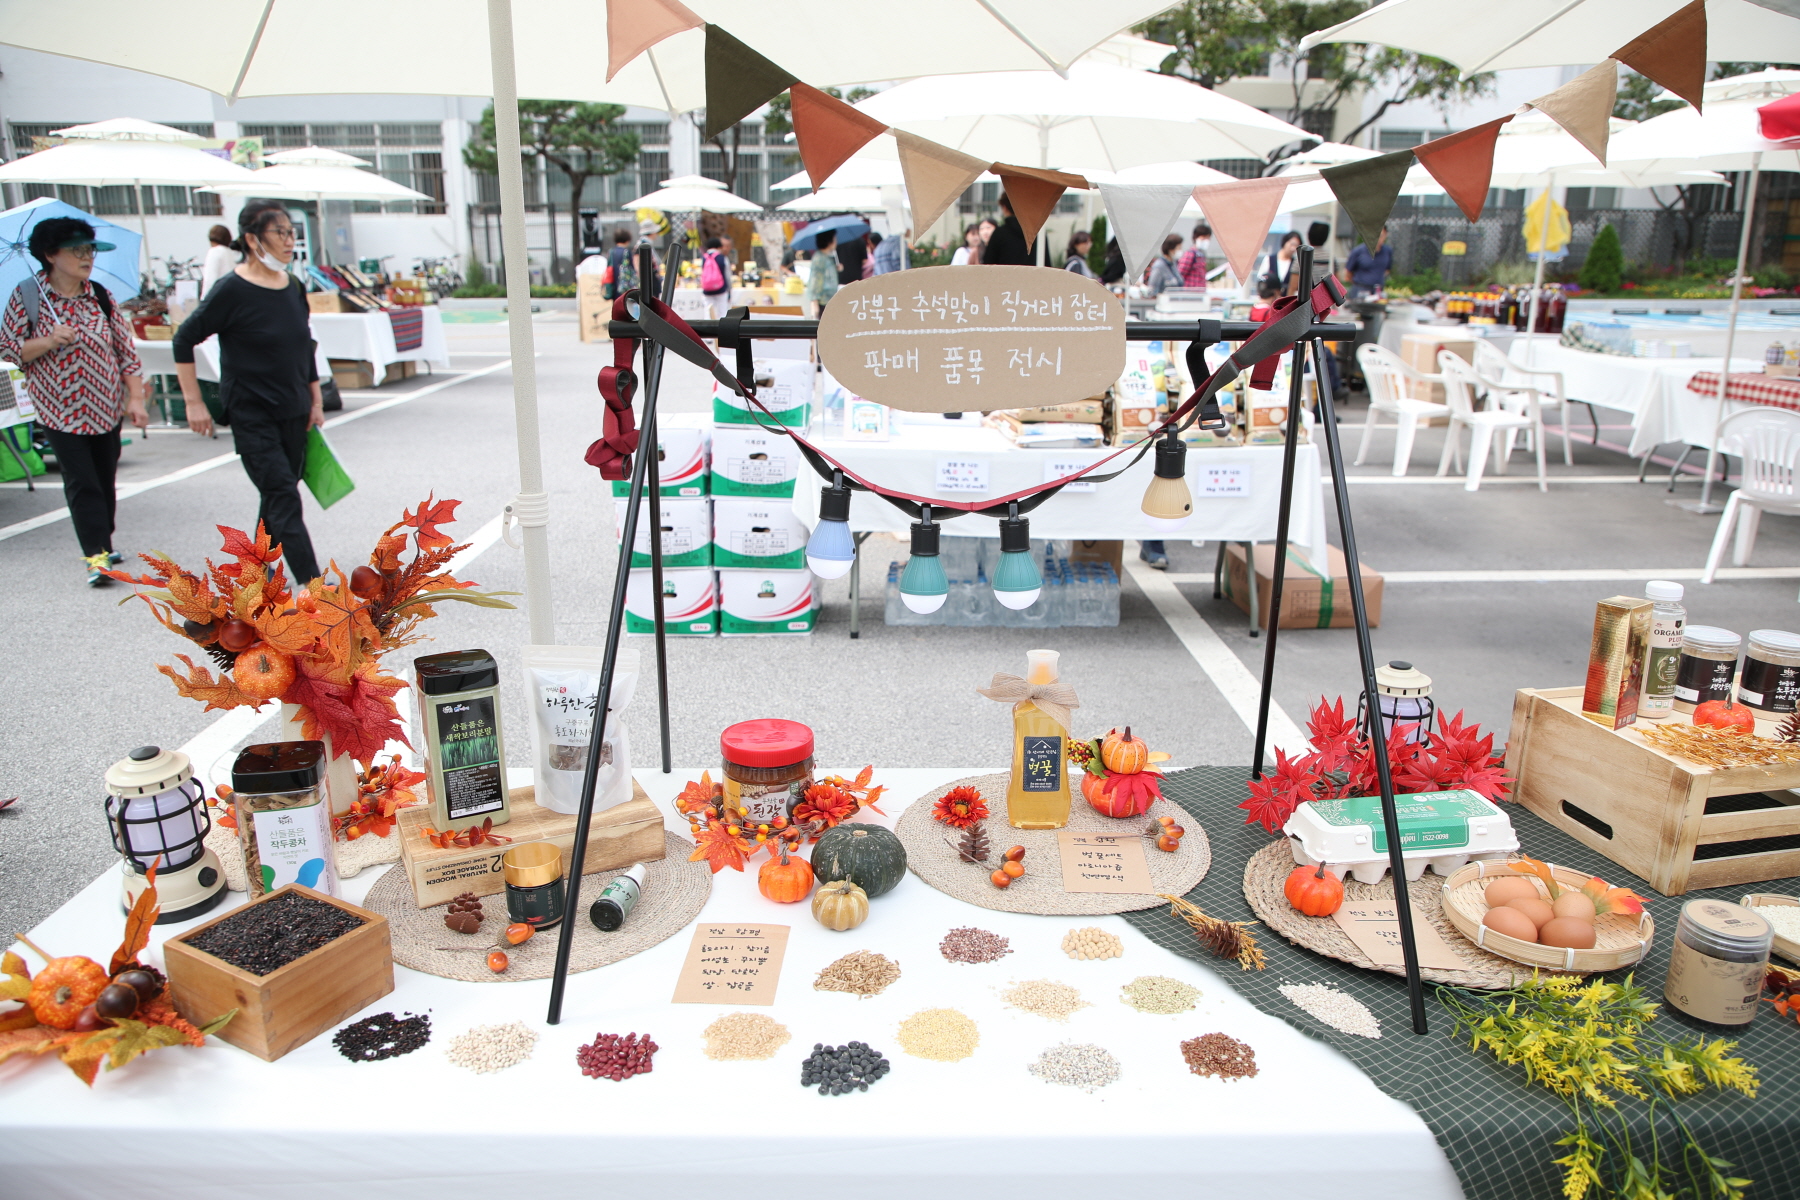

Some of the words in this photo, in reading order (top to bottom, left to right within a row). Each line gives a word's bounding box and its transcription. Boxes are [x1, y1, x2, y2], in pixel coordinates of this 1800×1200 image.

[848, 294, 902, 325] 강북구
[911, 290, 991, 324] 추석맞이
[1000, 290, 1063, 323] 직거래
[1069, 293, 1108, 322] 장터
[863, 347, 919, 377] 판매
[940, 346, 986, 385] 품목
[1006, 346, 1062, 377] 전시
[451, 719, 485, 732] 산들품은
[445, 727, 492, 742] 새싹보리분말
[1028, 760, 1052, 776] 벌꿀
[753, 803, 782, 818] 된장
[269, 827, 305, 840] 산들품은
[270, 837, 307, 850] 작두콩차
[442, 869, 456, 877] BOX
[457, 863, 488, 874] STORAGE
[458, 869, 488, 879] NATURAL
[426, 875, 457, 886] WOODEN
